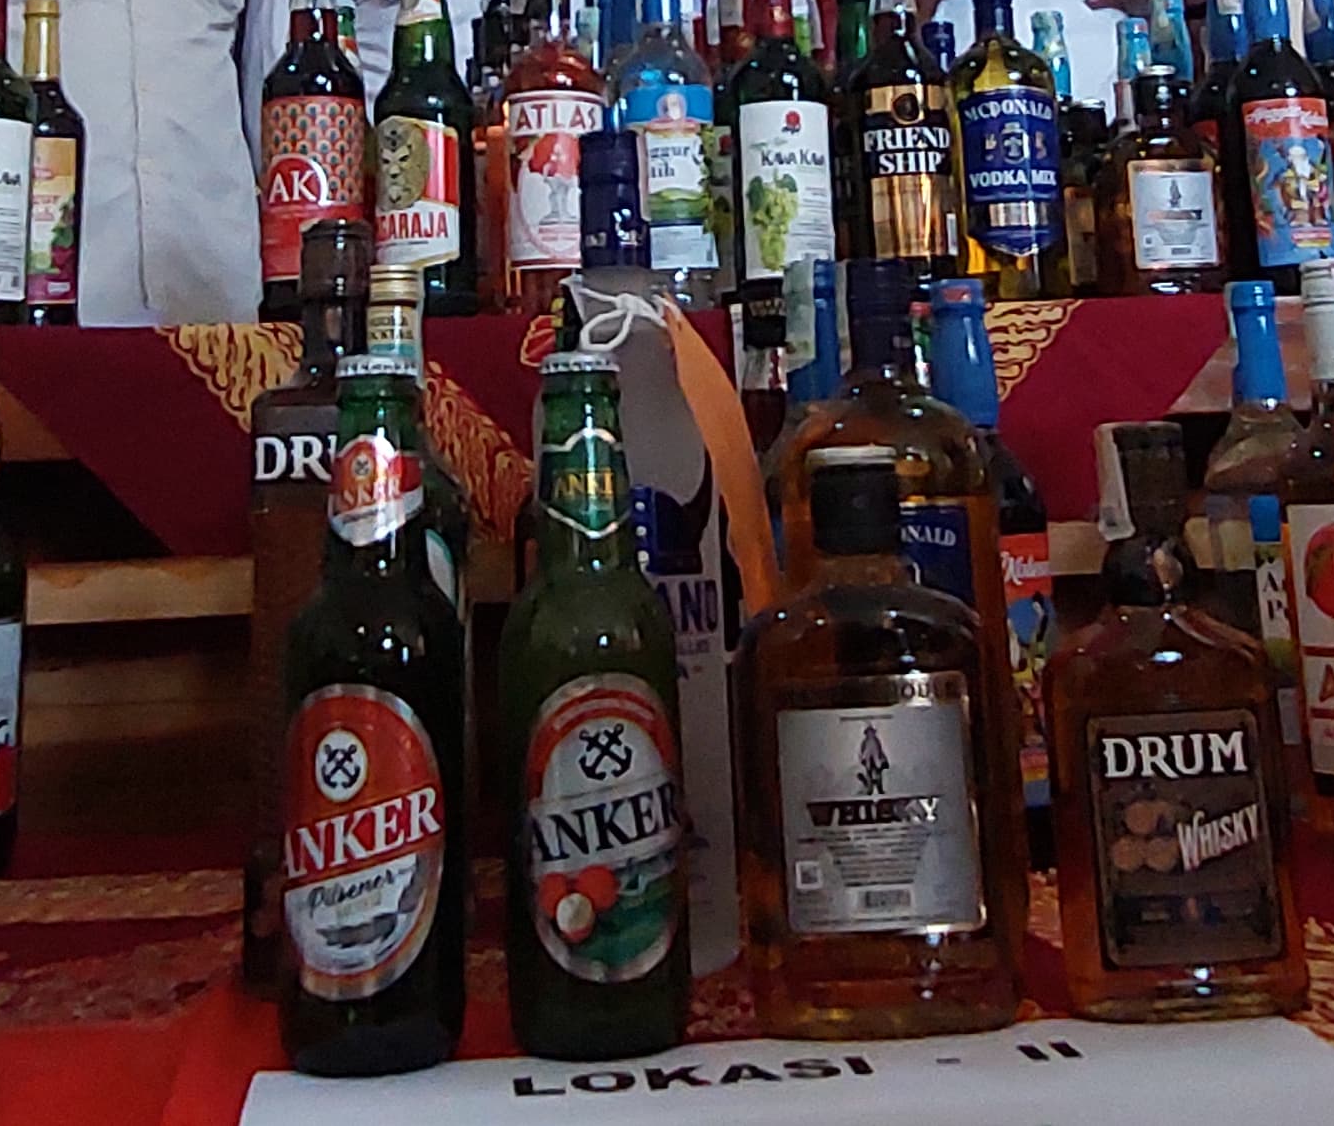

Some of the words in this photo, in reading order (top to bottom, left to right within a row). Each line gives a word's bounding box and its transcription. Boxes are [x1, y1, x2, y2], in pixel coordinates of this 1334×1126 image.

[514, 103, 597, 132] ATLAS
[963, 99, 1054, 123] MCDONALD
[864, 126, 950, 153] FRIEND
[879, 152, 942, 175] SHIP
[969, 169, 1028, 189] VODKA
[254, 434, 337, 481] DR
[1101, 729, 1249, 779] DRUM
[530, 782, 683, 863] ANKER
[511, 1055, 874, 1098] LOKASI
